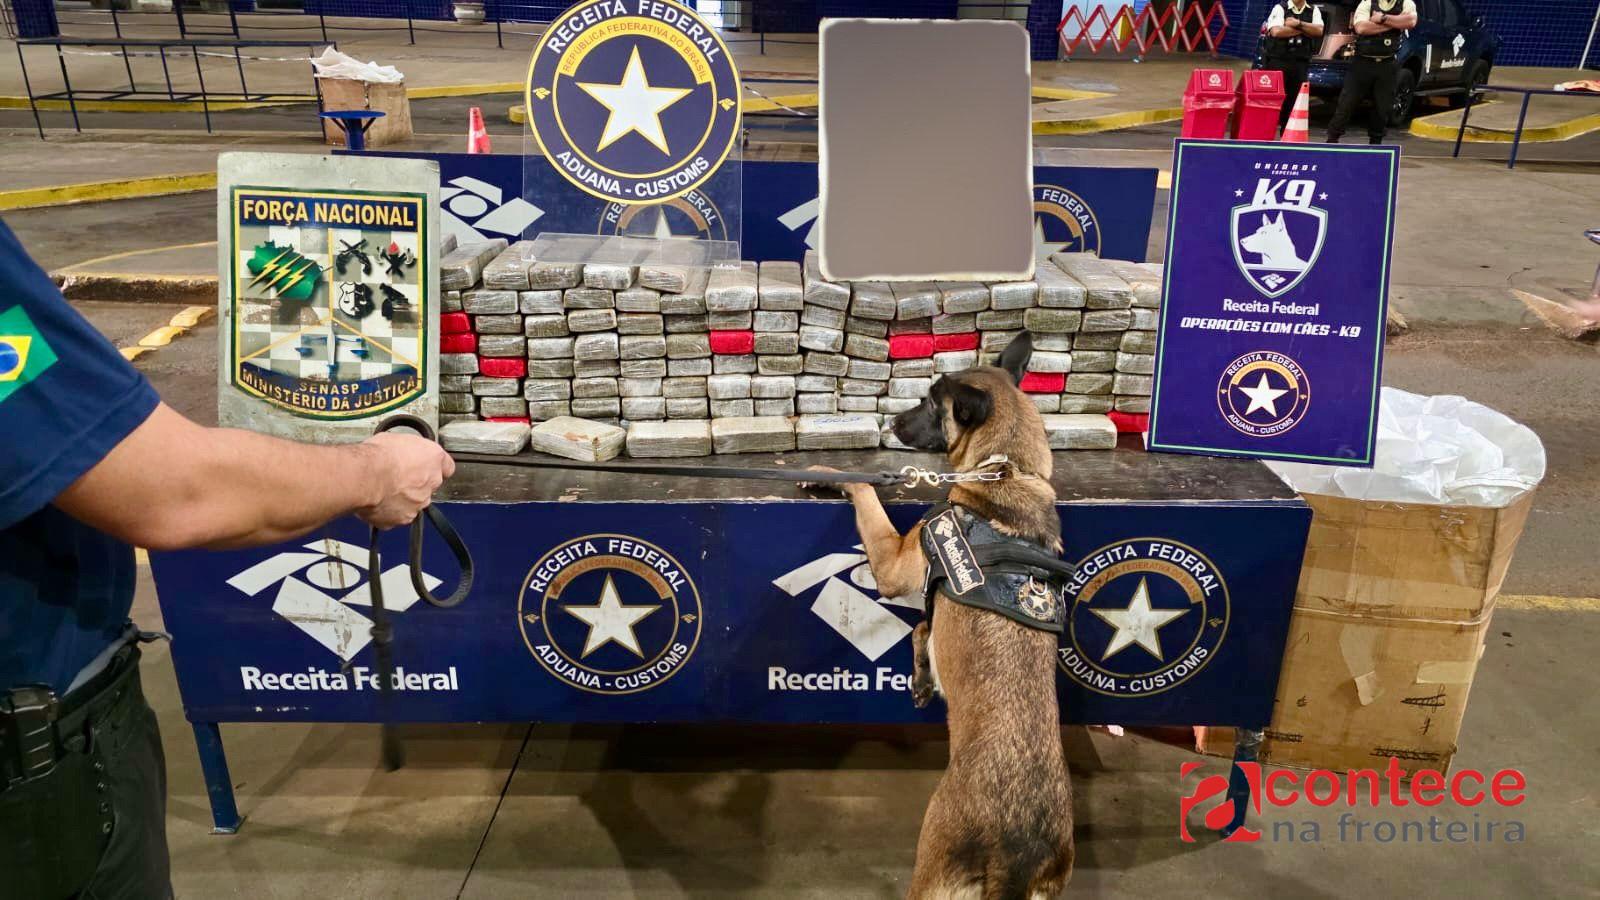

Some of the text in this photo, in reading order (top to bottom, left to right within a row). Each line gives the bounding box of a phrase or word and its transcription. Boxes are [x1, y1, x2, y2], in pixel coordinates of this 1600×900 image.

[548, 1, 720, 63] RECEITA FEDERAL
[607, 23, 668, 39] FEDERATIVA
[670, 36, 684, 48] DO
[684, 47, 707, 80] BRASIL
[557, 151, 621, 195] ADUANA
[634, 157, 710, 197] CUSTOMS
[1252, 178, 1317, 207] K9
[243, 200, 414, 226] FORÇA NACIONAL
[1042, 189, 1093, 232] FEDERAL
[1223, 299, 1319, 315] Receita Federal
[1180, 317, 1260, 332] OPERAÇÕES
[1262, 322, 1292, 334] COM
[1293, 322, 1330, 336] CÃES
[1339, 326, 1361, 338] K9
[1227, 354, 1262, 376] RECEITA
[1266, 354, 1302, 380] FEDERAL
[242, 368, 326, 410] MINISTÉRIO
[354, 375, 417, 408] JUSTIÇA
[299, 383, 359, 395] SENASP
[1228, 414, 1255, 433] ADUANA
[1260, 417, 1294, 434] CUSTOMS
[530, 541, 597, 592] RECEITA
[608, 539, 686, 592] FEDERAL
[1064, 544, 1137, 596] RECEITA
[1148, 543, 1220, 597] FEDERAL
[240, 666, 459, 691] Receita Federal
[536, 643, 601, 688] ADUANA
[614, 642, 688, 690] CUSTOMS
[768, 667, 869, 691] Receita
[1059, 646, 1117, 691] ADUANA
[1129, 646, 1209, 692] CUSTOMS
